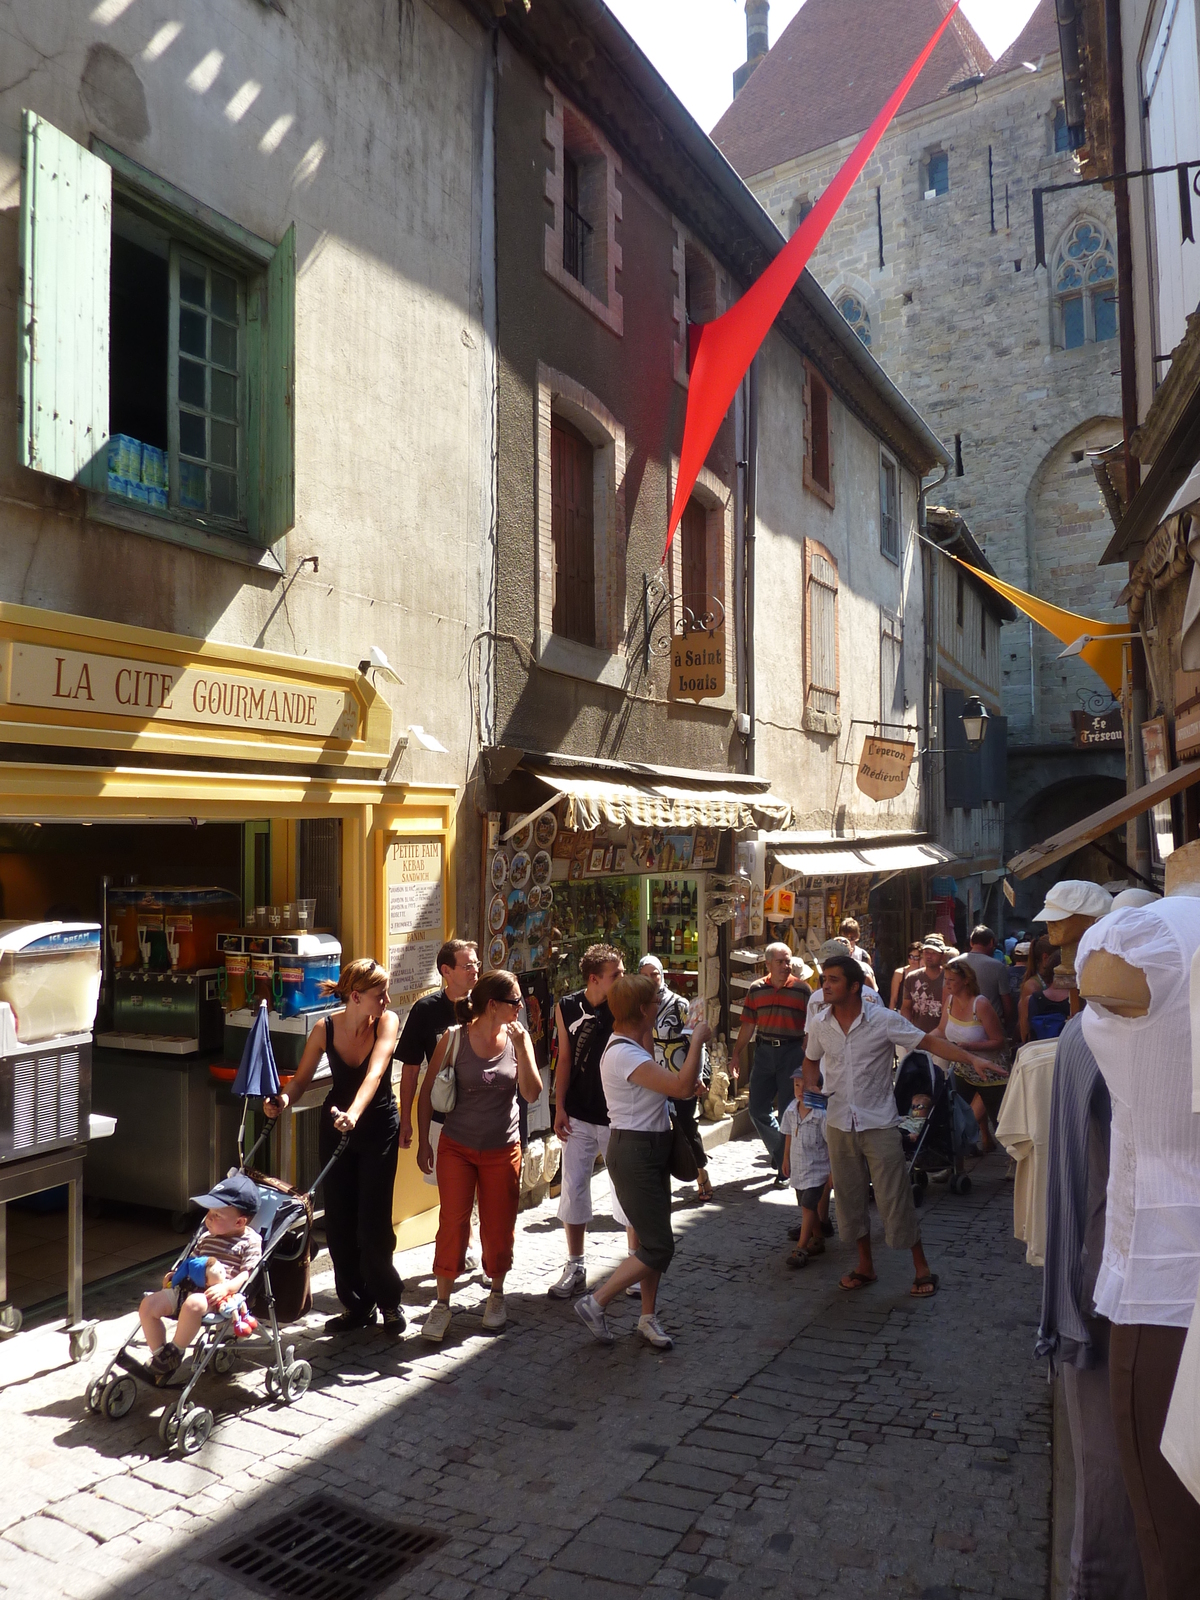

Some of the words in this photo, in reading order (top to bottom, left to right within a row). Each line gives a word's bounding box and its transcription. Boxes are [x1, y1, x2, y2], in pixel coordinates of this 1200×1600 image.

[674, 651, 682, 668] à
[686, 648, 722, 667] Saint
[679, 674, 717, 692] Louis
[52, 657, 95, 702] LA
[114, 668, 174, 710] CITE
[192, 679, 318, 726] GOURMANDE
[1092, 717, 1106, 730] Le
[860, 764, 905, 782] Médiéval
[403, 860, 425, 872] KEBAB
[402, 872, 429, 882] SANDWICH
[63, 932, 90, 943] DREAM
[407, 932, 425, 942] PANINI
[400, 994, 411, 1005] PAN
